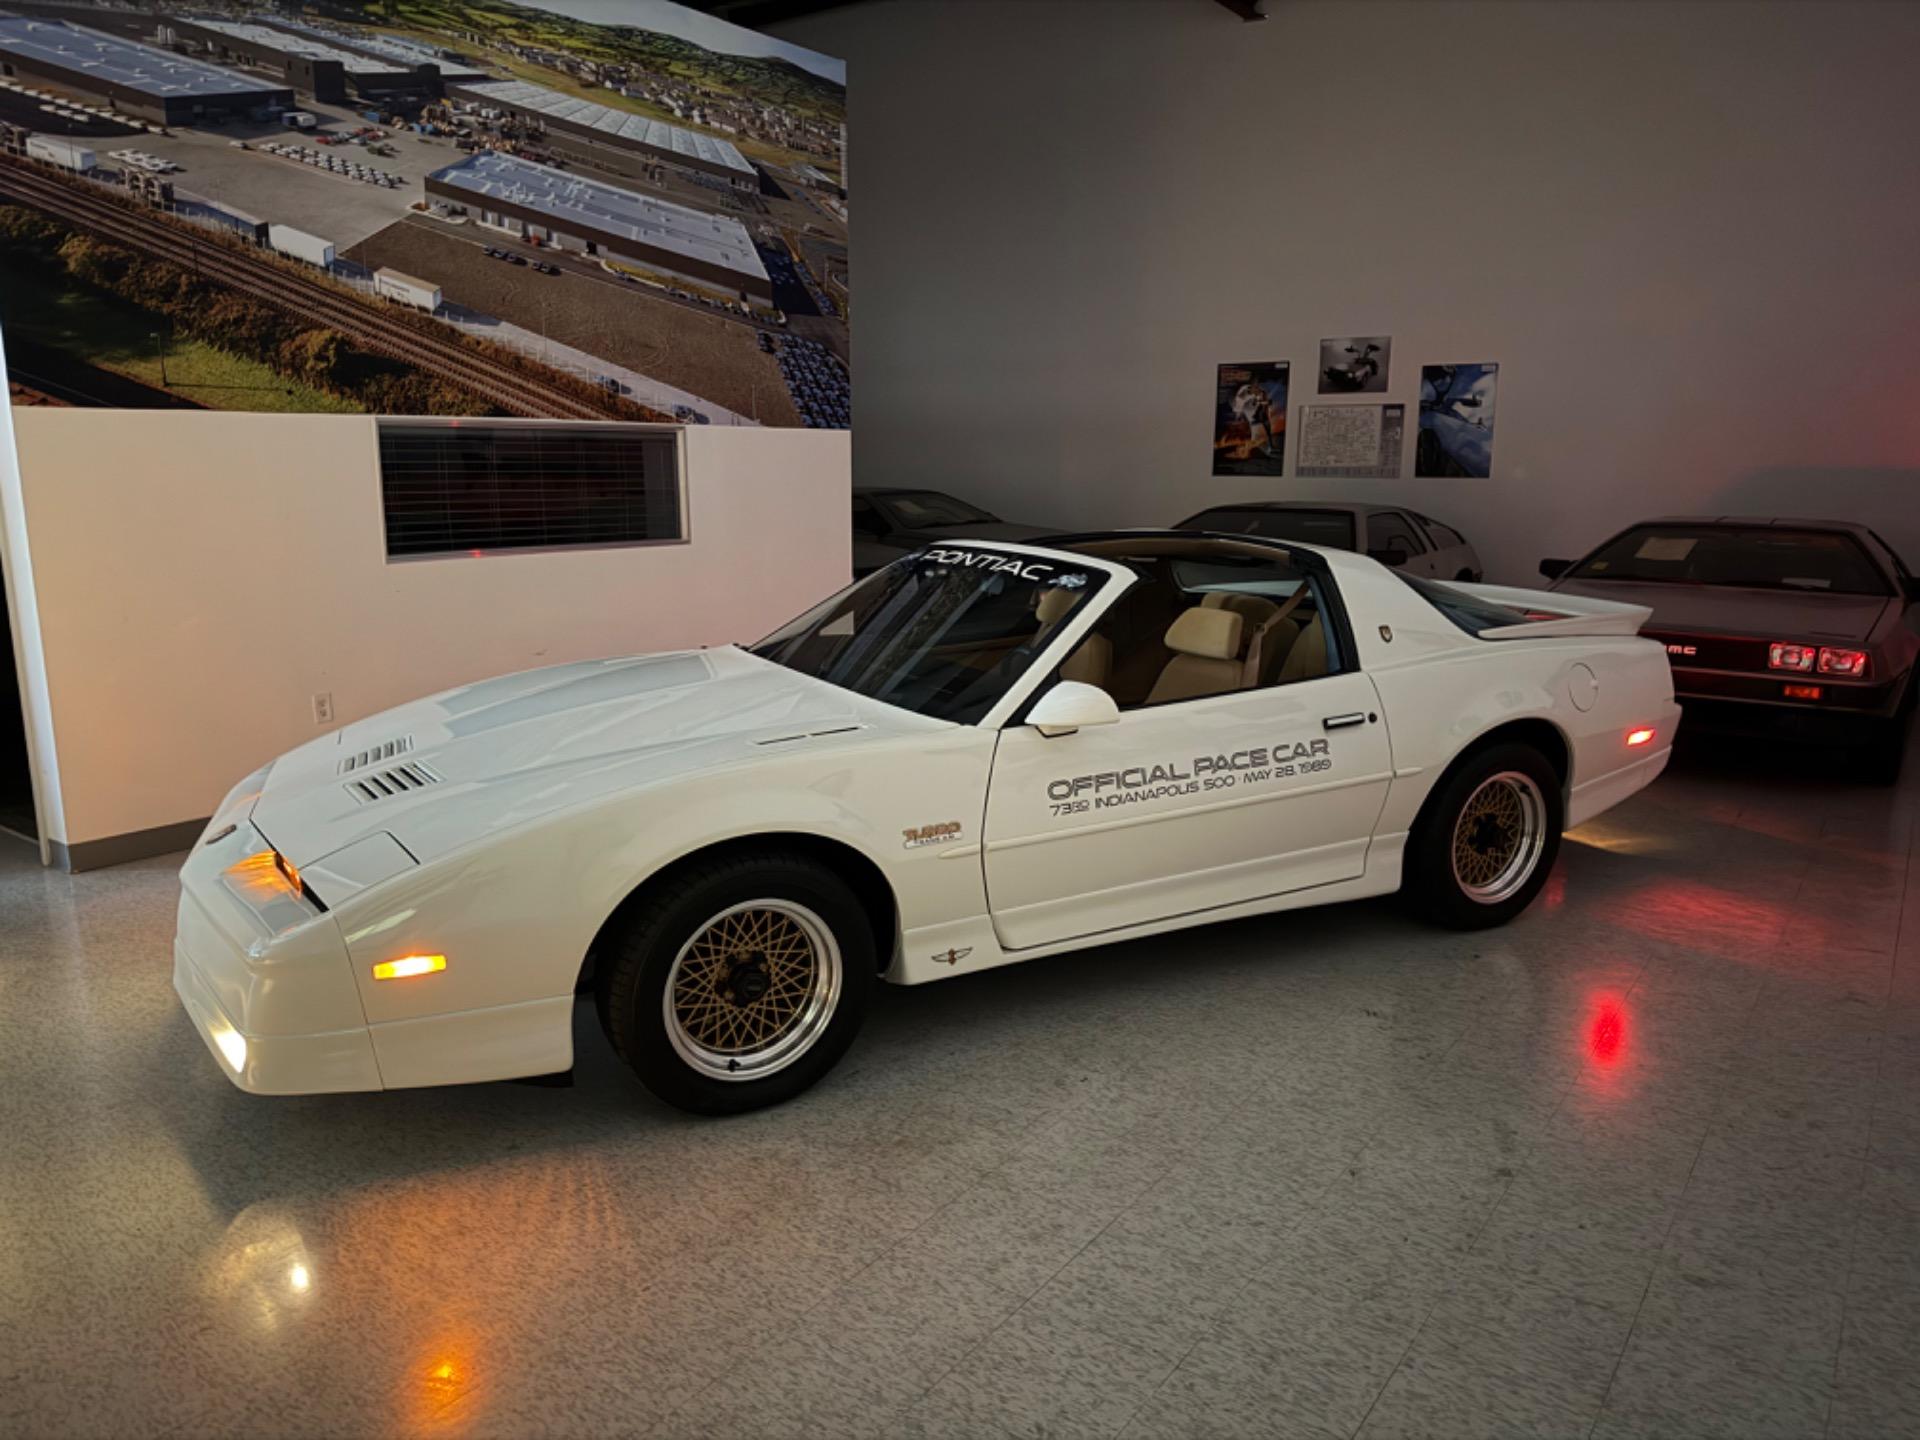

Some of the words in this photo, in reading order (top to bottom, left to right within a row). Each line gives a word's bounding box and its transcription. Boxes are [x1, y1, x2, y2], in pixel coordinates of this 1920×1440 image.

[920, 550, 1055, 581] PONTIAC
[1664, 644, 1697, 655] MC
[1047, 763, 1190, 801] OFFICIAL
[1193, 747, 1269, 775] PACE
[1272, 738, 1330, 763] CAR
[1095, 780, 1200, 809] INDIANAPOLIS
[1203, 774, 1235, 791] 500
[1243, 769, 1273, 784] MAY
[1299, 758, 1332, 773] 1989
